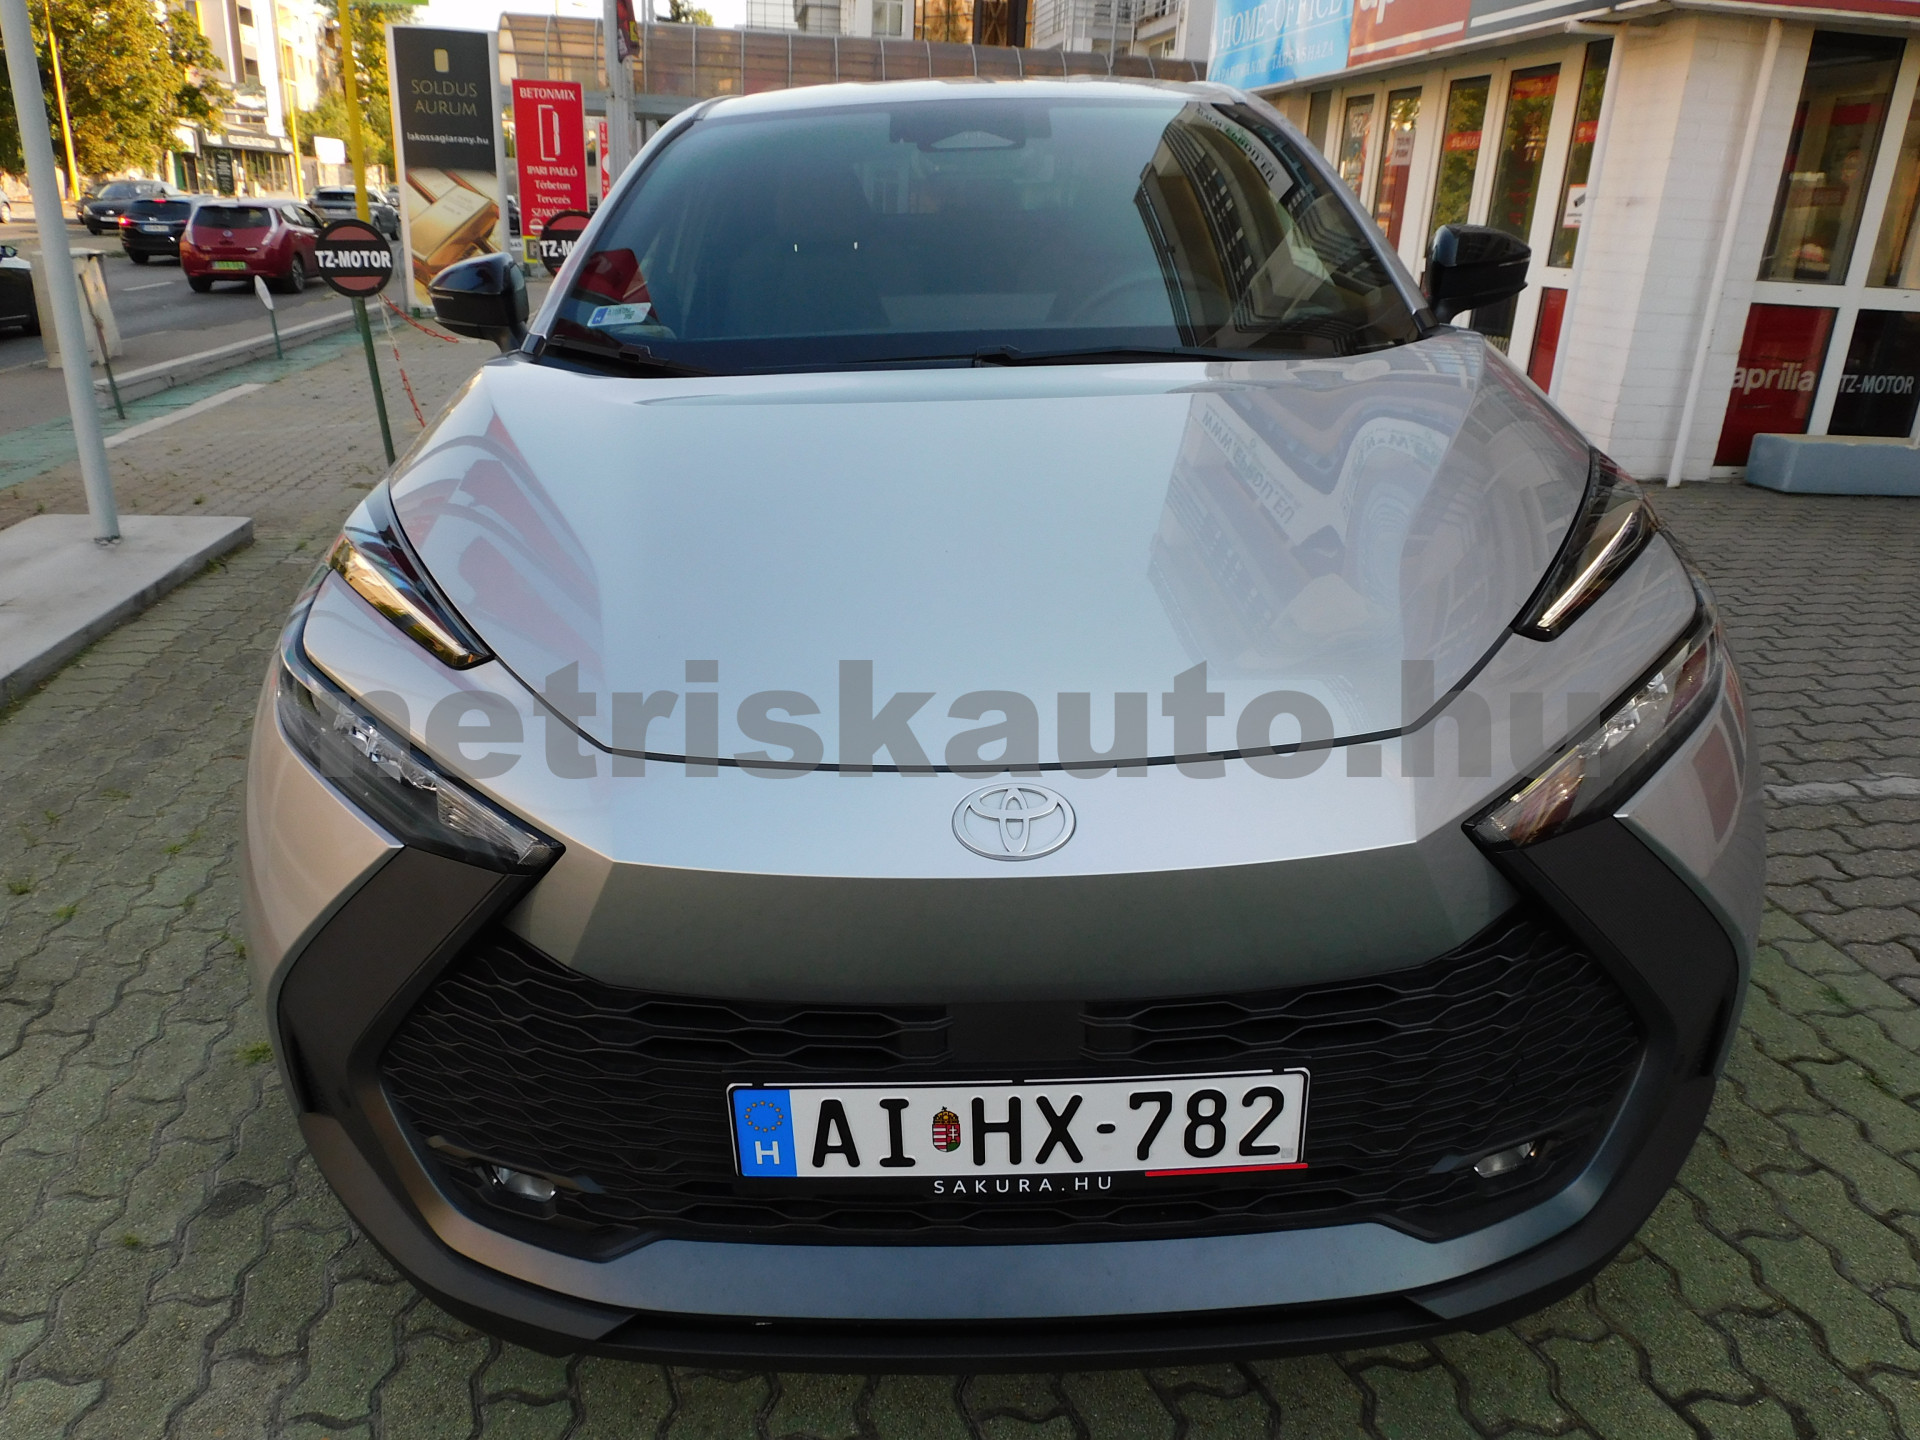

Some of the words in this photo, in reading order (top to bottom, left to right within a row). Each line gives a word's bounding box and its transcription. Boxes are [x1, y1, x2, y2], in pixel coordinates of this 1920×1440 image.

[411, 79, 478, 98] SOLDUS
[519, 87, 576, 101] BETONMIX
[415, 100, 478, 117] AURUM
[407, 132, 489, 146] lakossagiarany.hu
[526, 165, 548, 176] IPARI
[549, 165, 578, 177] PADLÓ
[534, 180, 571, 190] Térbeton
[536, 194, 571, 204] Tervezés
[531, 206, 570, 218] SZAKÉ
[539, 239, 575, 258] TZ-M
[315, 250, 392, 268] TZ-MOTOR
[1732, 362, 1815, 394] aprilia
[1840, 374, 1914, 394] TZ-MOTOR
[811, 1097, 917, 1168] AI
[971, 1086, 1286, 1166] HX-782
[754, 1140, 780, 1165] H
[933, 1175, 1113, 1195] SAKURA.HU
